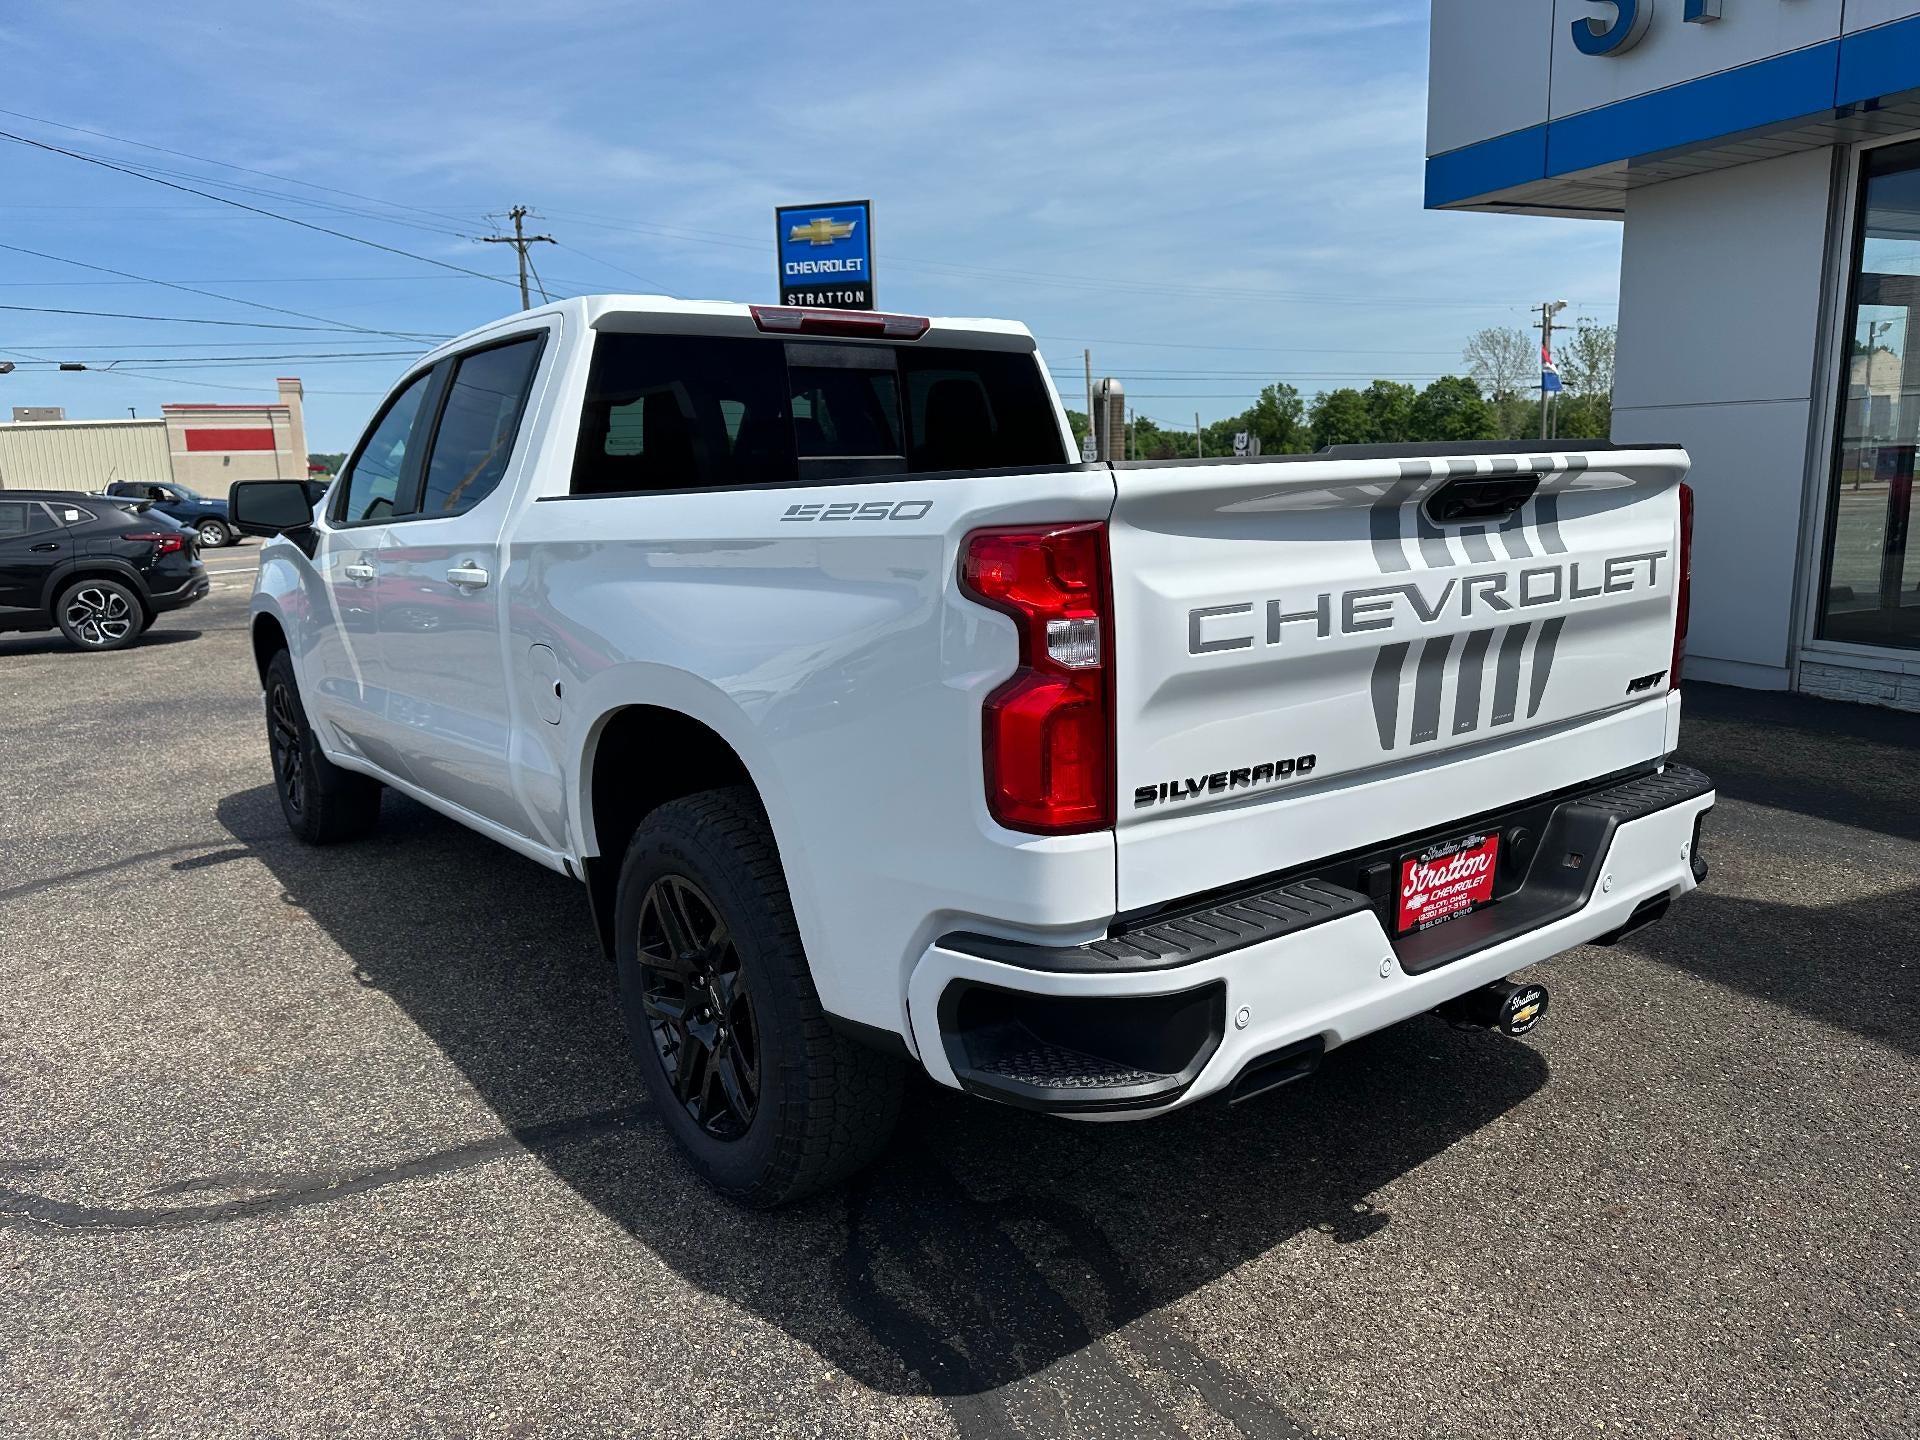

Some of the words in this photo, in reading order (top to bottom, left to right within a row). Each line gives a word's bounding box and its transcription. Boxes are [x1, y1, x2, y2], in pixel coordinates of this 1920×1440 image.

[786, 259, 863, 275] CHEVROLET
[788, 291, 865, 305] STRATTON
[1188, 550, 1668, 655] CHEVROLET
[1626, 669, 1668, 693] RST
[1134, 753, 1317, 806] SILVERADO
[1403, 851, 1493, 897] Stratton
[1430, 875, 1487, 901] CHEVROLET
[1453, 906, 1473, 919] OHIO
